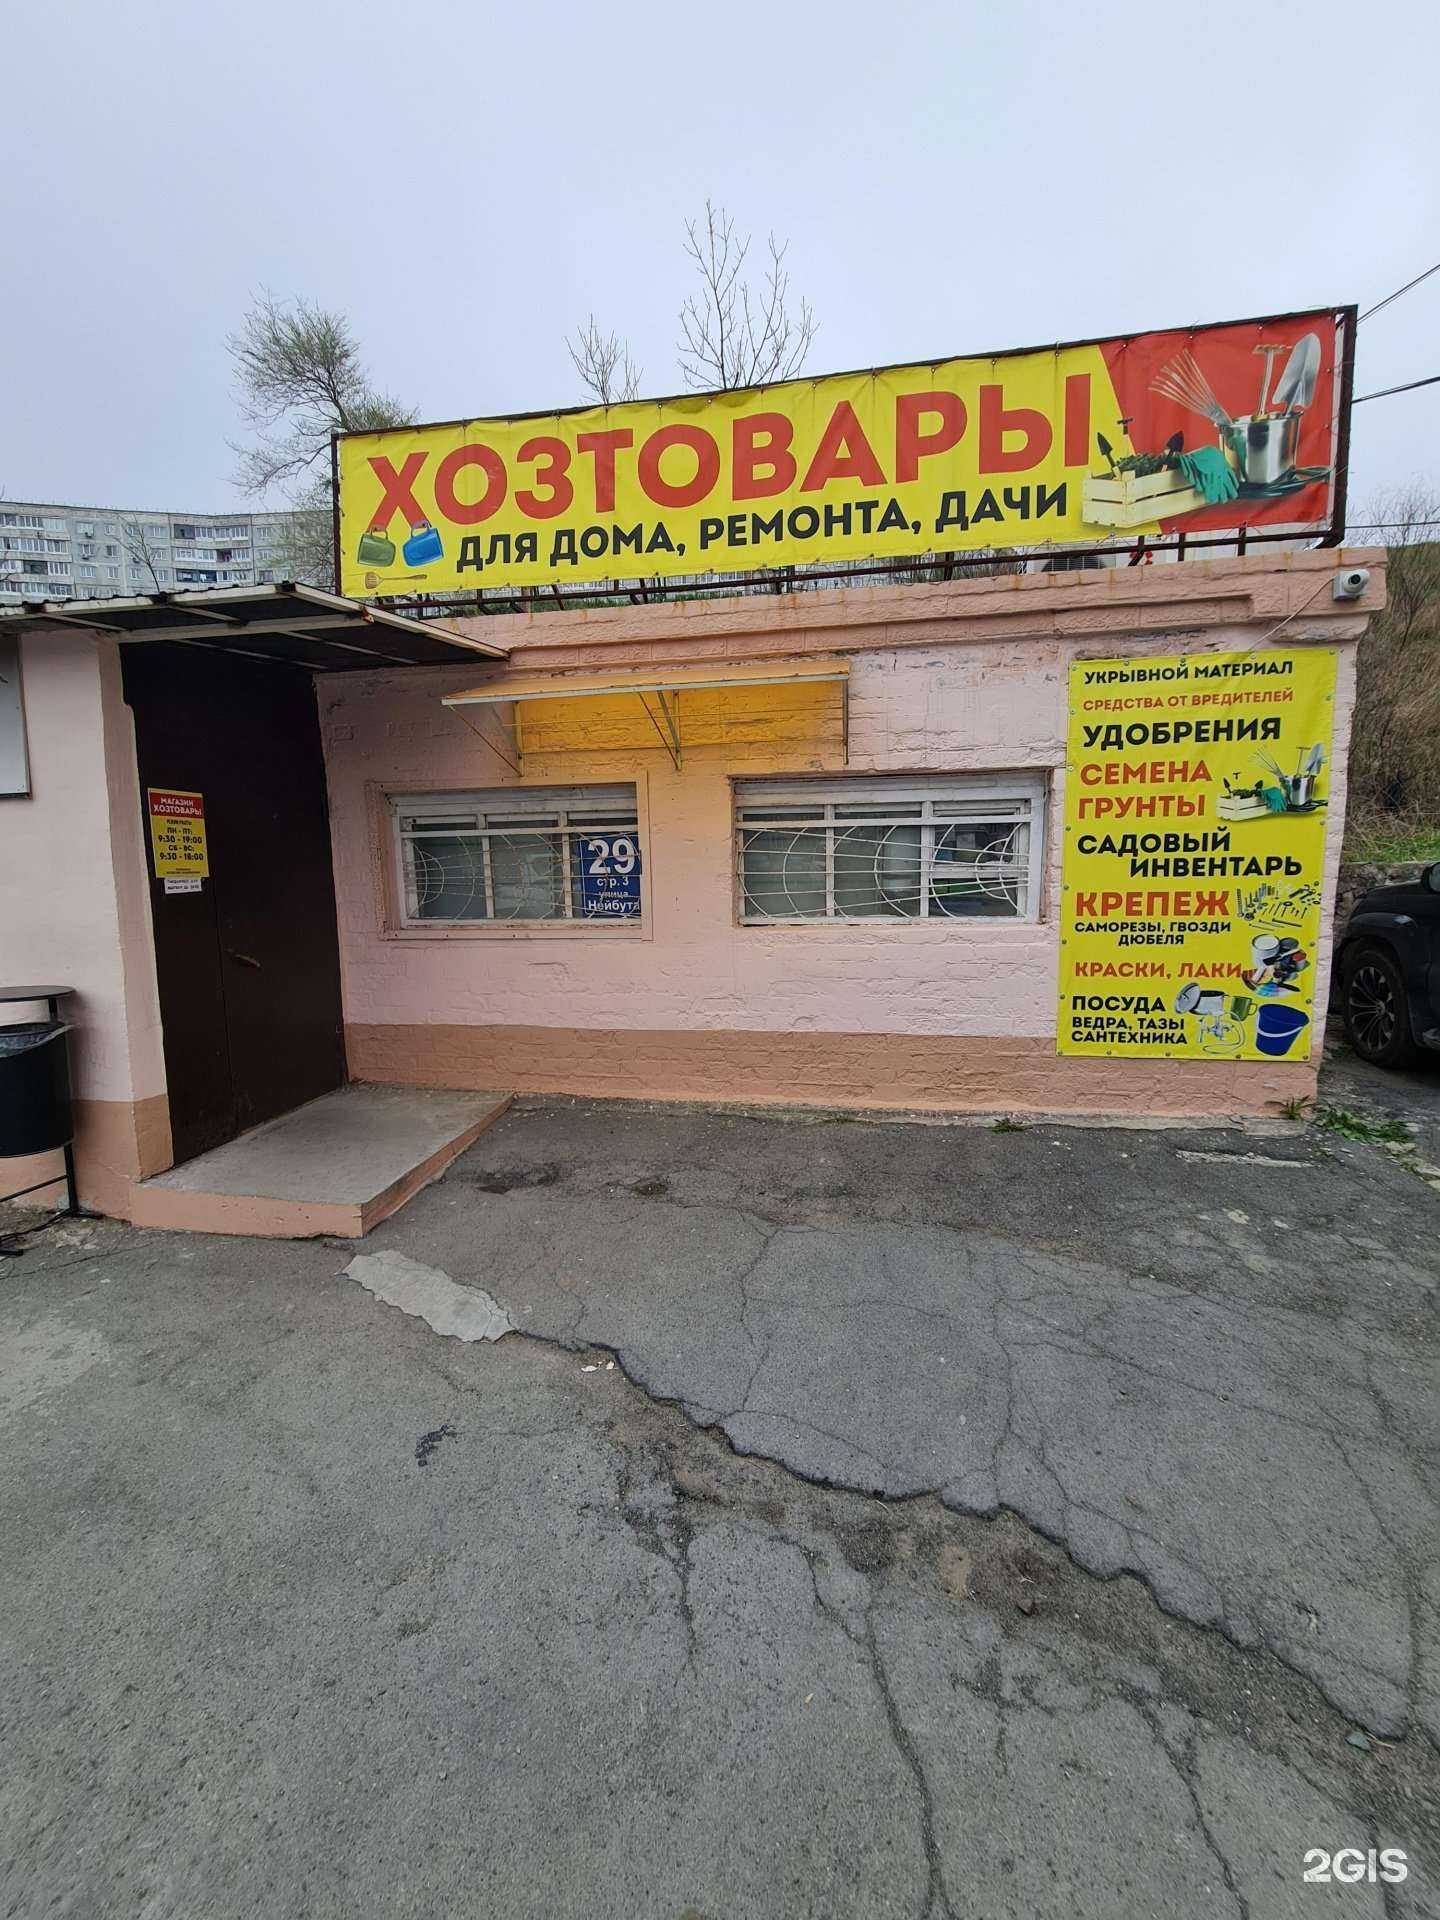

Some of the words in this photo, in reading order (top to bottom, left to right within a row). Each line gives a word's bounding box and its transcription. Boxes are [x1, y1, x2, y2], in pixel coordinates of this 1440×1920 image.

[367, 373, 1091, 531] ХОЗТОВАРЫ
[456, 531, 538, 573] ДЛЯ
[550, 521, 686, 567] ДОМА,
[700, 498, 921, 550] РЕМОНТА,
[935, 482, 1067, 533] ДАЧИ
[1084, 664, 1189, 685] УКРЫВНОЙ
[1194, 661, 1293, 679] МАТЕРИАЛ
[1083, 696, 1164, 712] СРЕДСТВА
[1168, 696, 1187, 707] ОТ
[1192, 688, 1293, 706] ВРЕДИТЕЛЕЙ
[1083, 717, 1281, 750] УДОБРЕНИЯ
[1080, 760, 1213, 786] СЕМЕНА
[153, 804, 202, 815] ХОЗТОВАРЫ
[160, 797, 194, 807] МАГАЗИН
[1078, 795, 1206, 819] ГРУНТЫ
[158, 834, 175, 843] 9:30
[1077, 826, 1231, 857] САДОВЫЙ
[159, 852, 176, 861] 9:30
[588, 839, 635, 874] 29
[1130, 856, 1302, 877] ИНВЕНТАРЬ
[622, 876, 629, 885] 3
[1075, 891, 1230, 917] КРЕПЕЖ
[1074, 921, 1165, 933] САМОРЕЗЫ,
[1170, 922, 1231, 932] ГВОЗДИ
[1118, 934, 1184, 946] ДЮБЕЛЯ
[1075, 962, 1171, 979] КРАСКИ,
[1178, 963, 1242, 978] ЛАКИ
[1072, 996, 1166, 1014] ПОСУДА
[1072, 1017, 1132, 1030] ВЕДРА,
[1138, 1018, 1185, 1030] ТАЗЫ
[1071, 1031, 1188, 1044] САНТЕХНИКА
